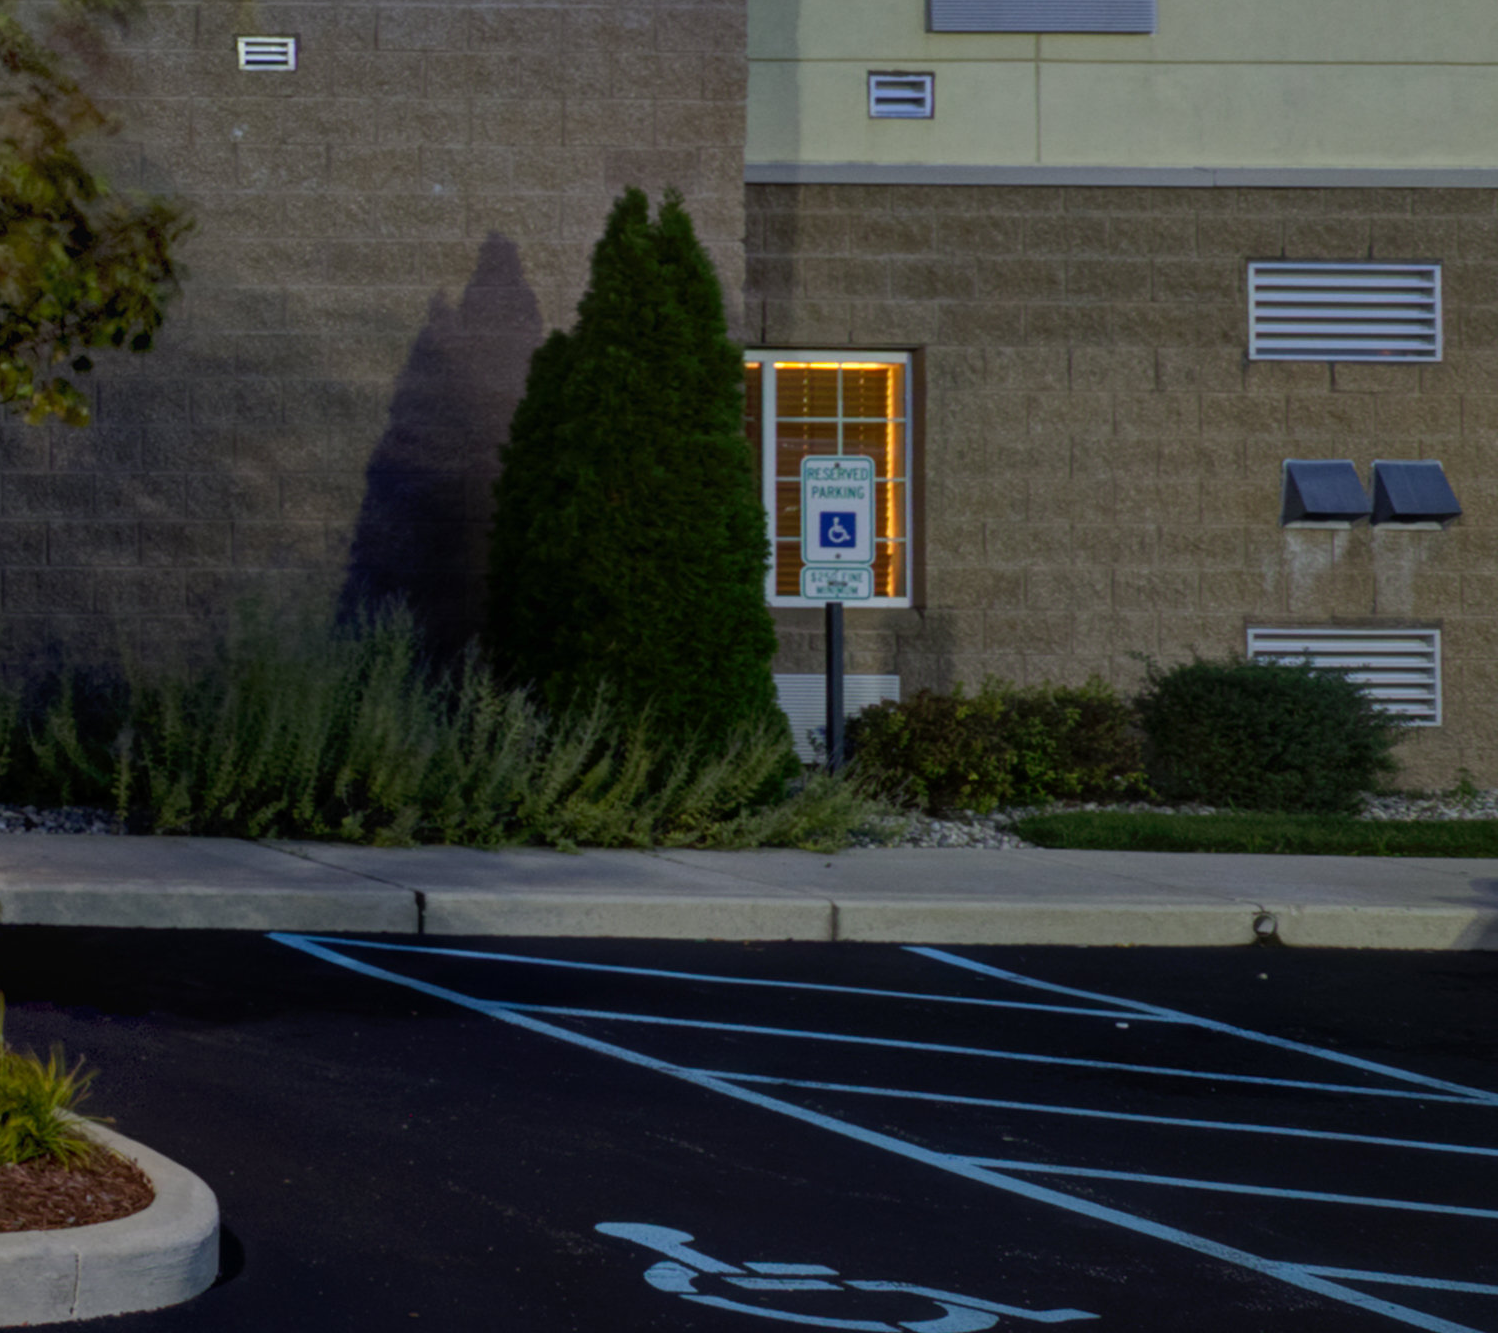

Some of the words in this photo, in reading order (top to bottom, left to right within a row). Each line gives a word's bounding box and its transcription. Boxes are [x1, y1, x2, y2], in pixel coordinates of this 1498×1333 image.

[807, 467, 869, 481] RESERVED
[811, 485, 865, 500] PARKING
[841, 572, 864, 583] FINE
